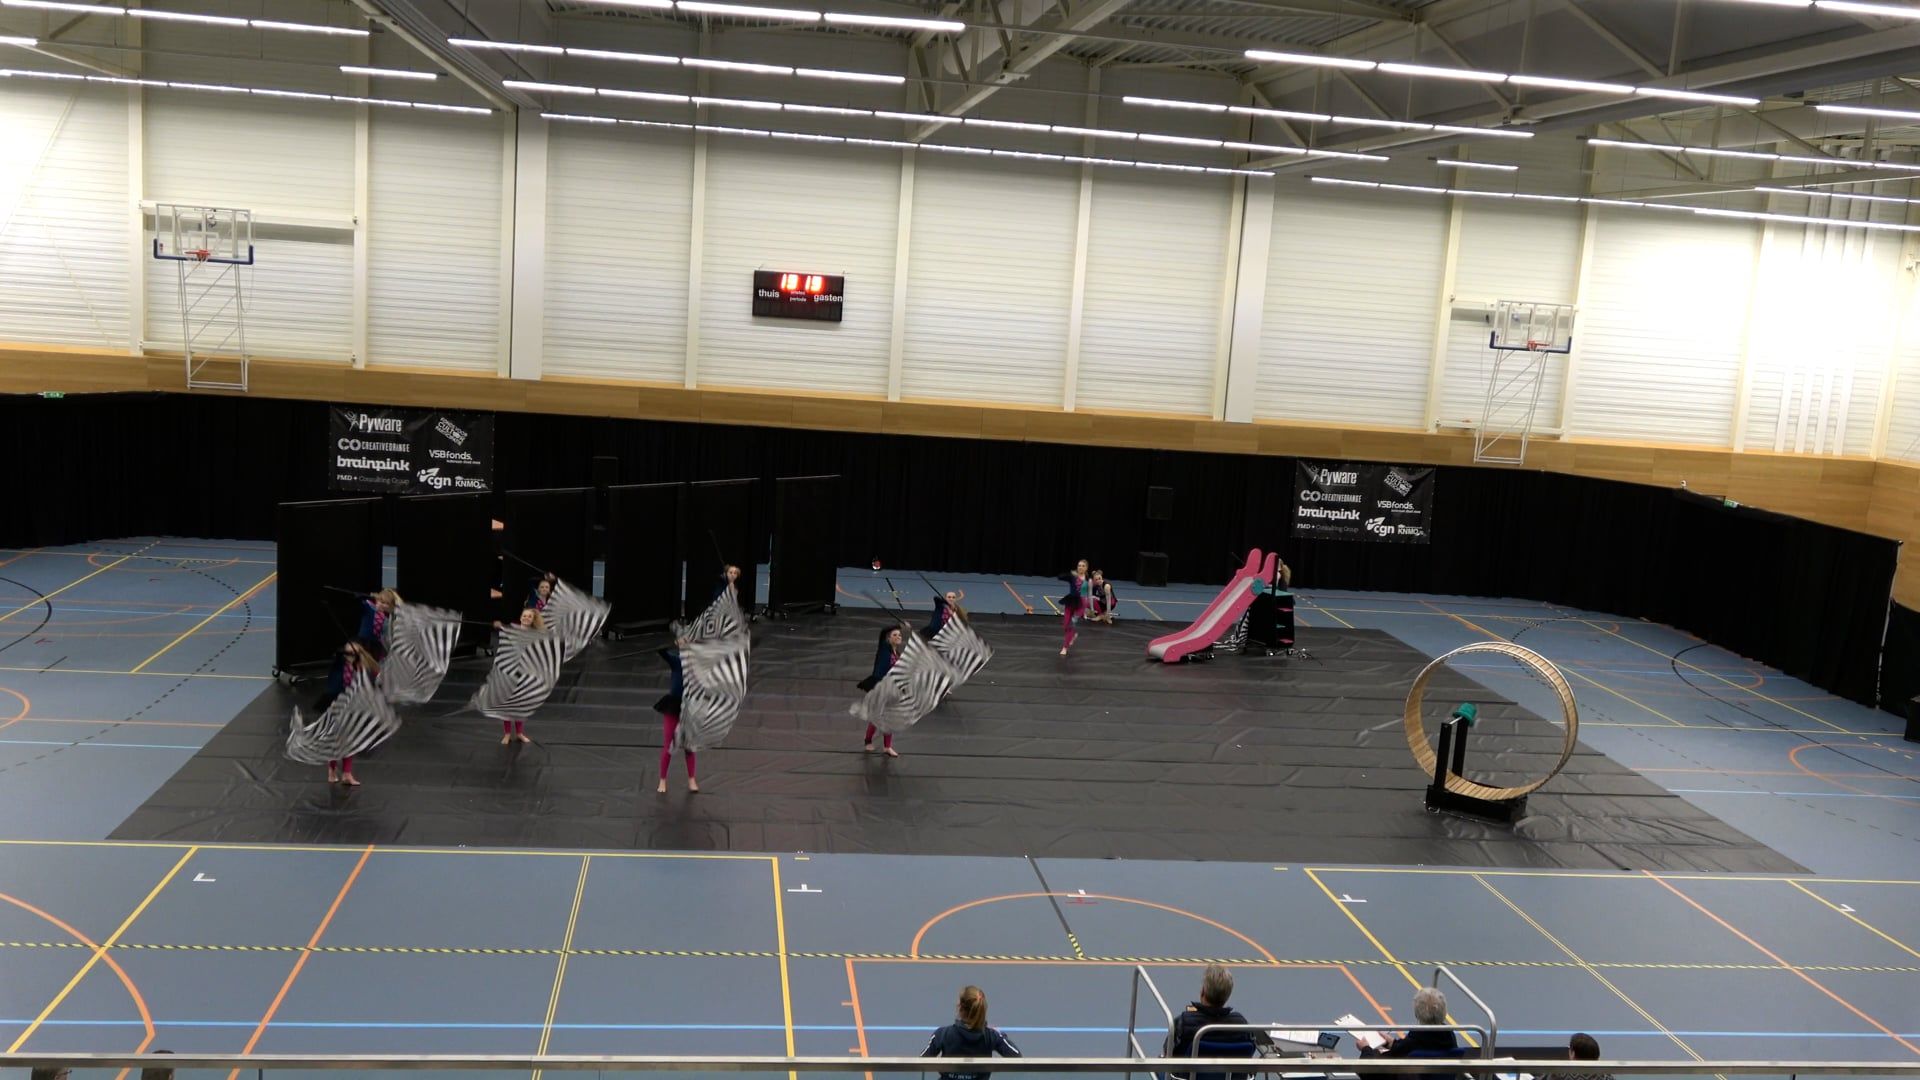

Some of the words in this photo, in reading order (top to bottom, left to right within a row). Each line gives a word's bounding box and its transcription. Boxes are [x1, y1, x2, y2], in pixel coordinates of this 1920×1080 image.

[758, 289, 779, 298] thuis
[814, 294, 843, 302] gasten
[359, 414, 402, 432] Pyware
[337, 455, 410, 471] brainpink
[427, 476, 452, 489] cgn
[1320, 468, 1358, 485] Pyware
[1298, 506, 1360, 520] brainpink
[1374, 524, 1394, 536] cgn
